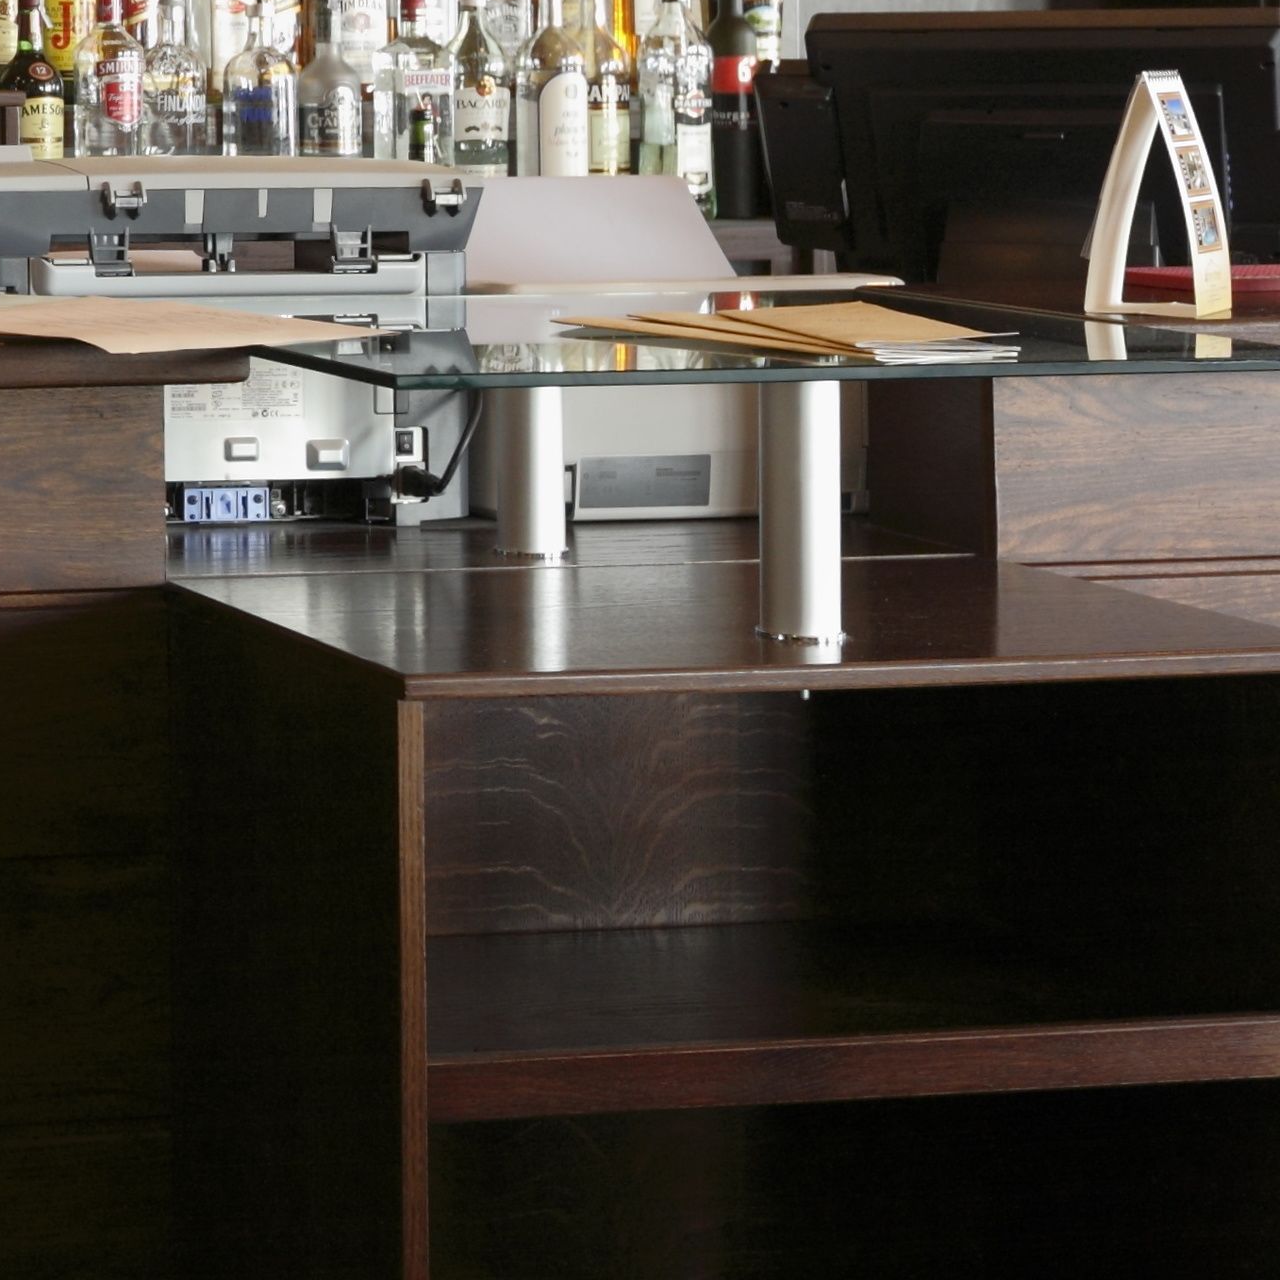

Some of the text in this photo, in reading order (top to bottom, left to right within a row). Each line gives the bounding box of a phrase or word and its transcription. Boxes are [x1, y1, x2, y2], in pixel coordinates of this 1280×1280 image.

[35, 66, 48, 75] 12
[99, 61, 146, 75] SMIRN
[404, 74, 452, 87] BEEFEATER
[156, 94, 207, 112] FINLANDI
[456, 99, 509, 109] BACARD
[20, 103, 64, 118] AMESO
